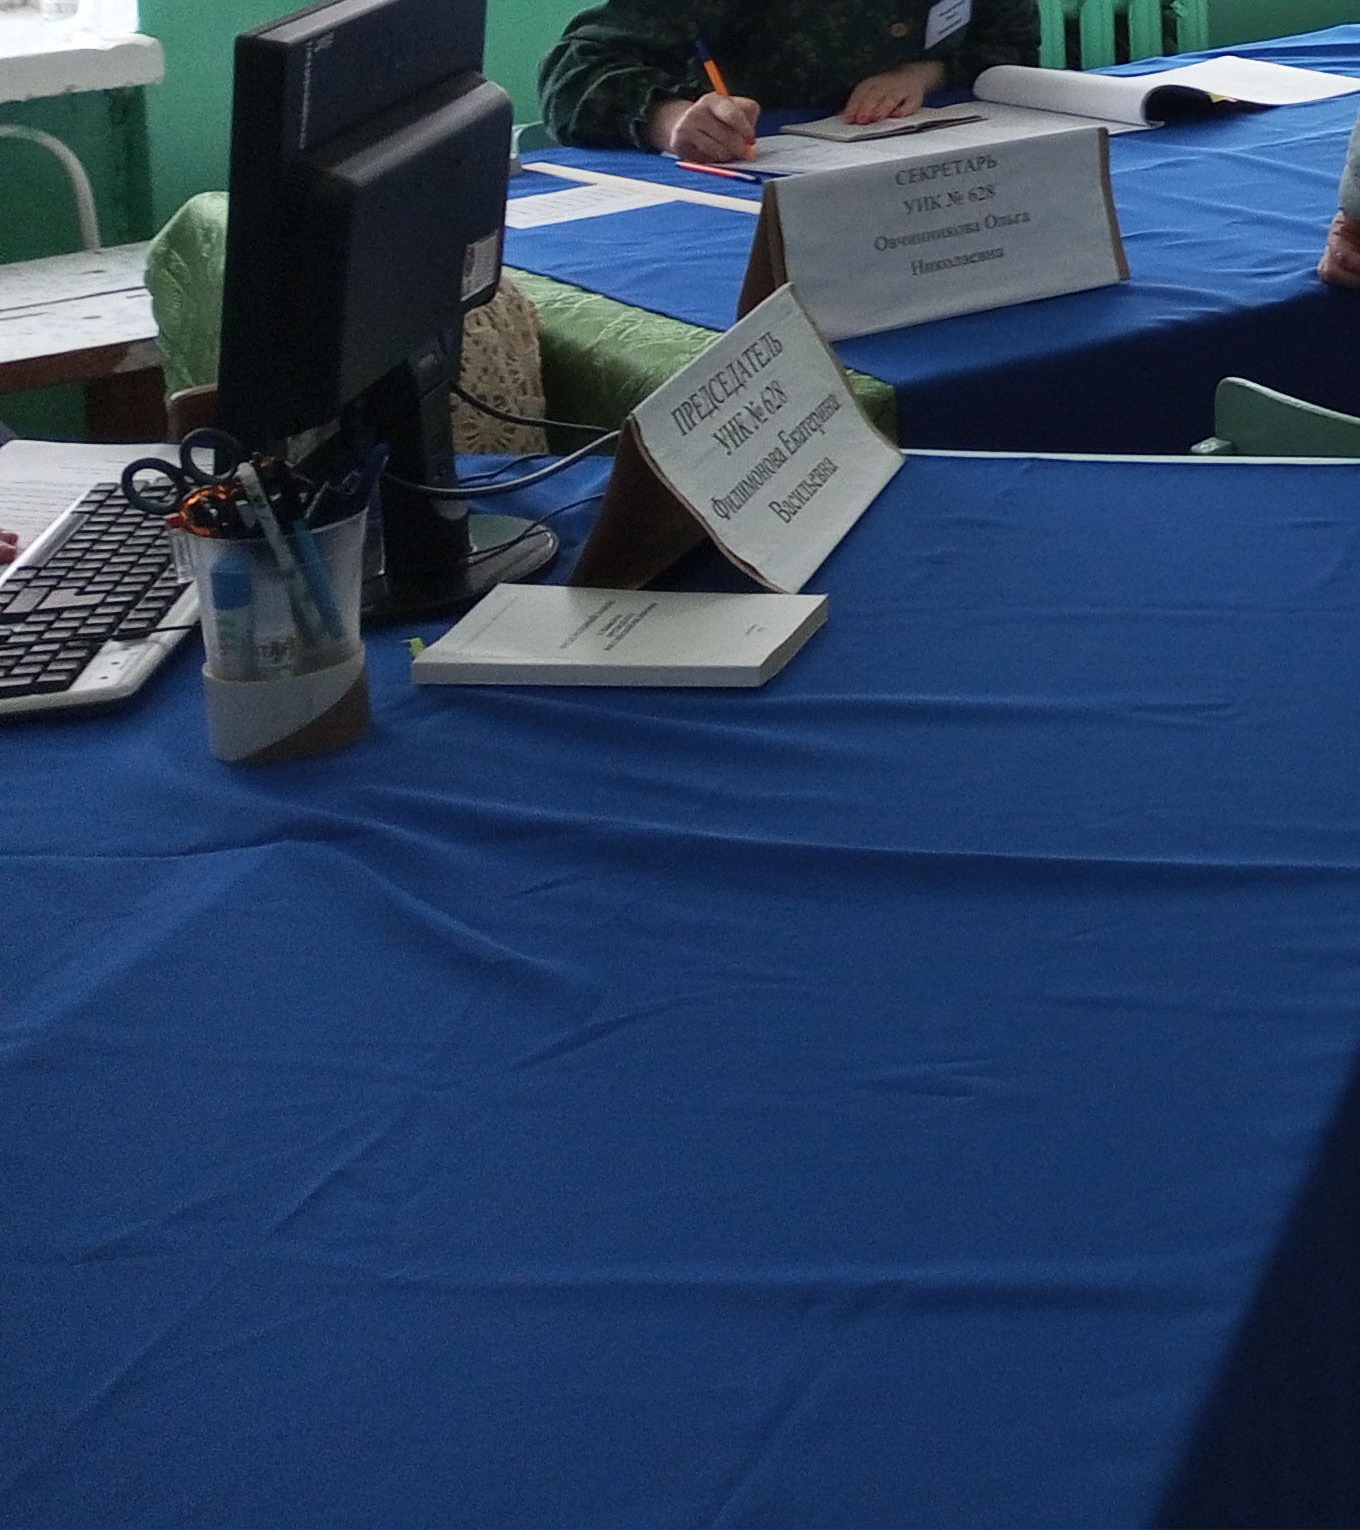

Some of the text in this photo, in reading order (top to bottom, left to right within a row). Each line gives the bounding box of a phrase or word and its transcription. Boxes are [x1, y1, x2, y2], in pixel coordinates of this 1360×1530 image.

[894, 154, 999, 186] СЕКРЕТАРЬ
[902, 194, 943, 216] УИК
[670, 331, 784, 437] ПРЕДСЕДАТЕЛЬ
[712, 412, 754, 455] УИК
[760, 380, 789, 415] 628
[710, 394, 841, 521] Филимонова Екатерина
[768, 456, 839, 524] Васильевна
